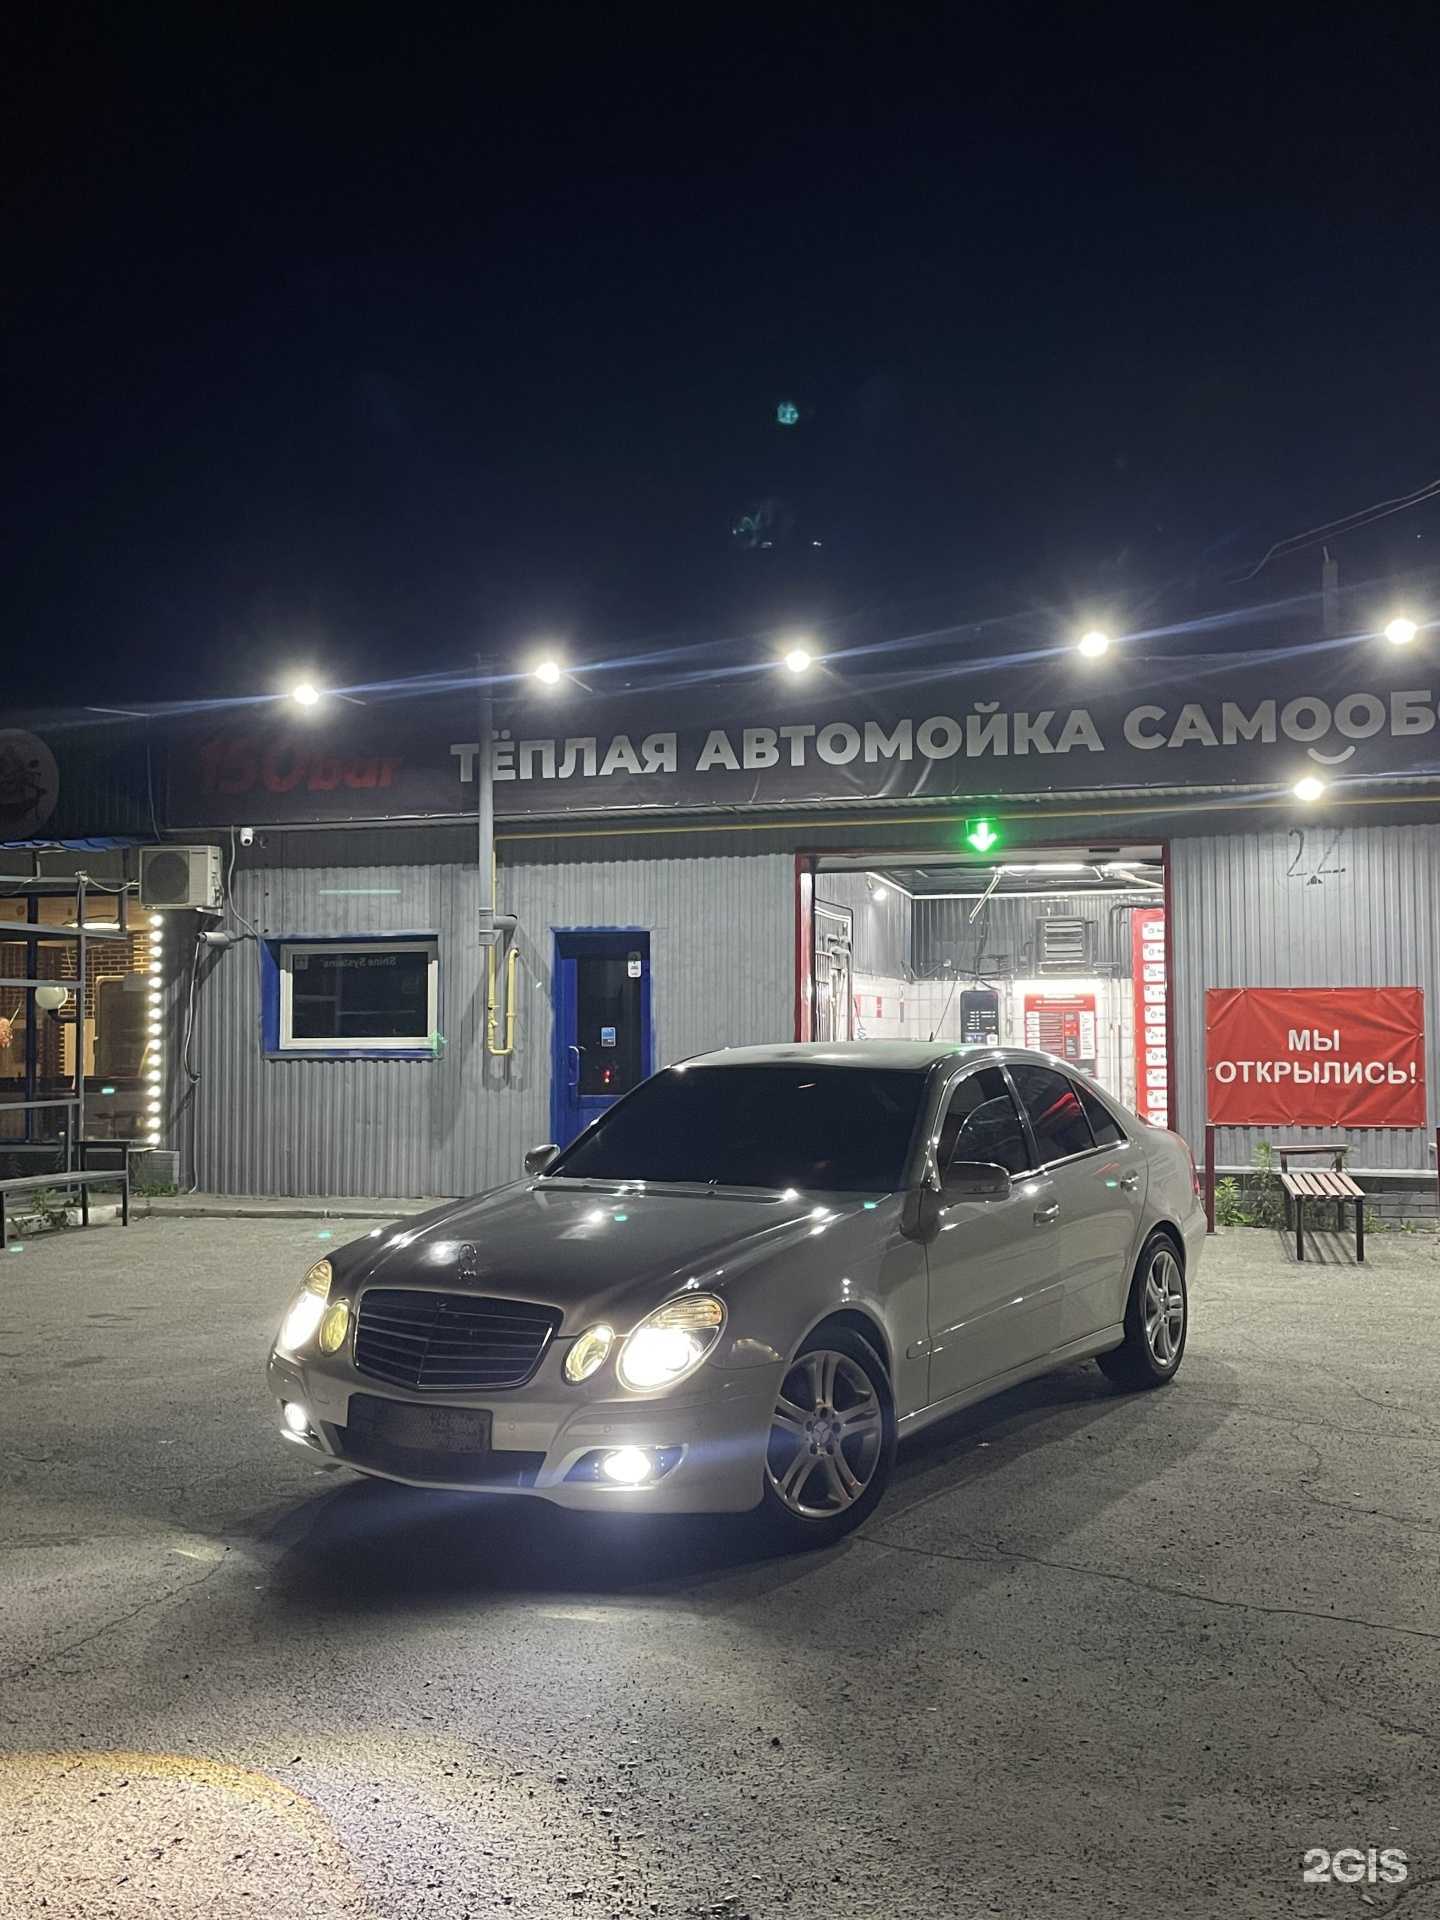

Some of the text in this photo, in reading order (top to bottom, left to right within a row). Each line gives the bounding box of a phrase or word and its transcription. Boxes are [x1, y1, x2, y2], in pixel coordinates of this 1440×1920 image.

[450, 690, 1440, 783] ТЁПЛАЯ АВТОМОЙКА САМООБ
[1288, 1029, 1341, 1052] МЫ
[1215, 1062, 1418, 1085] ОТКРЫЛИСЬ!
